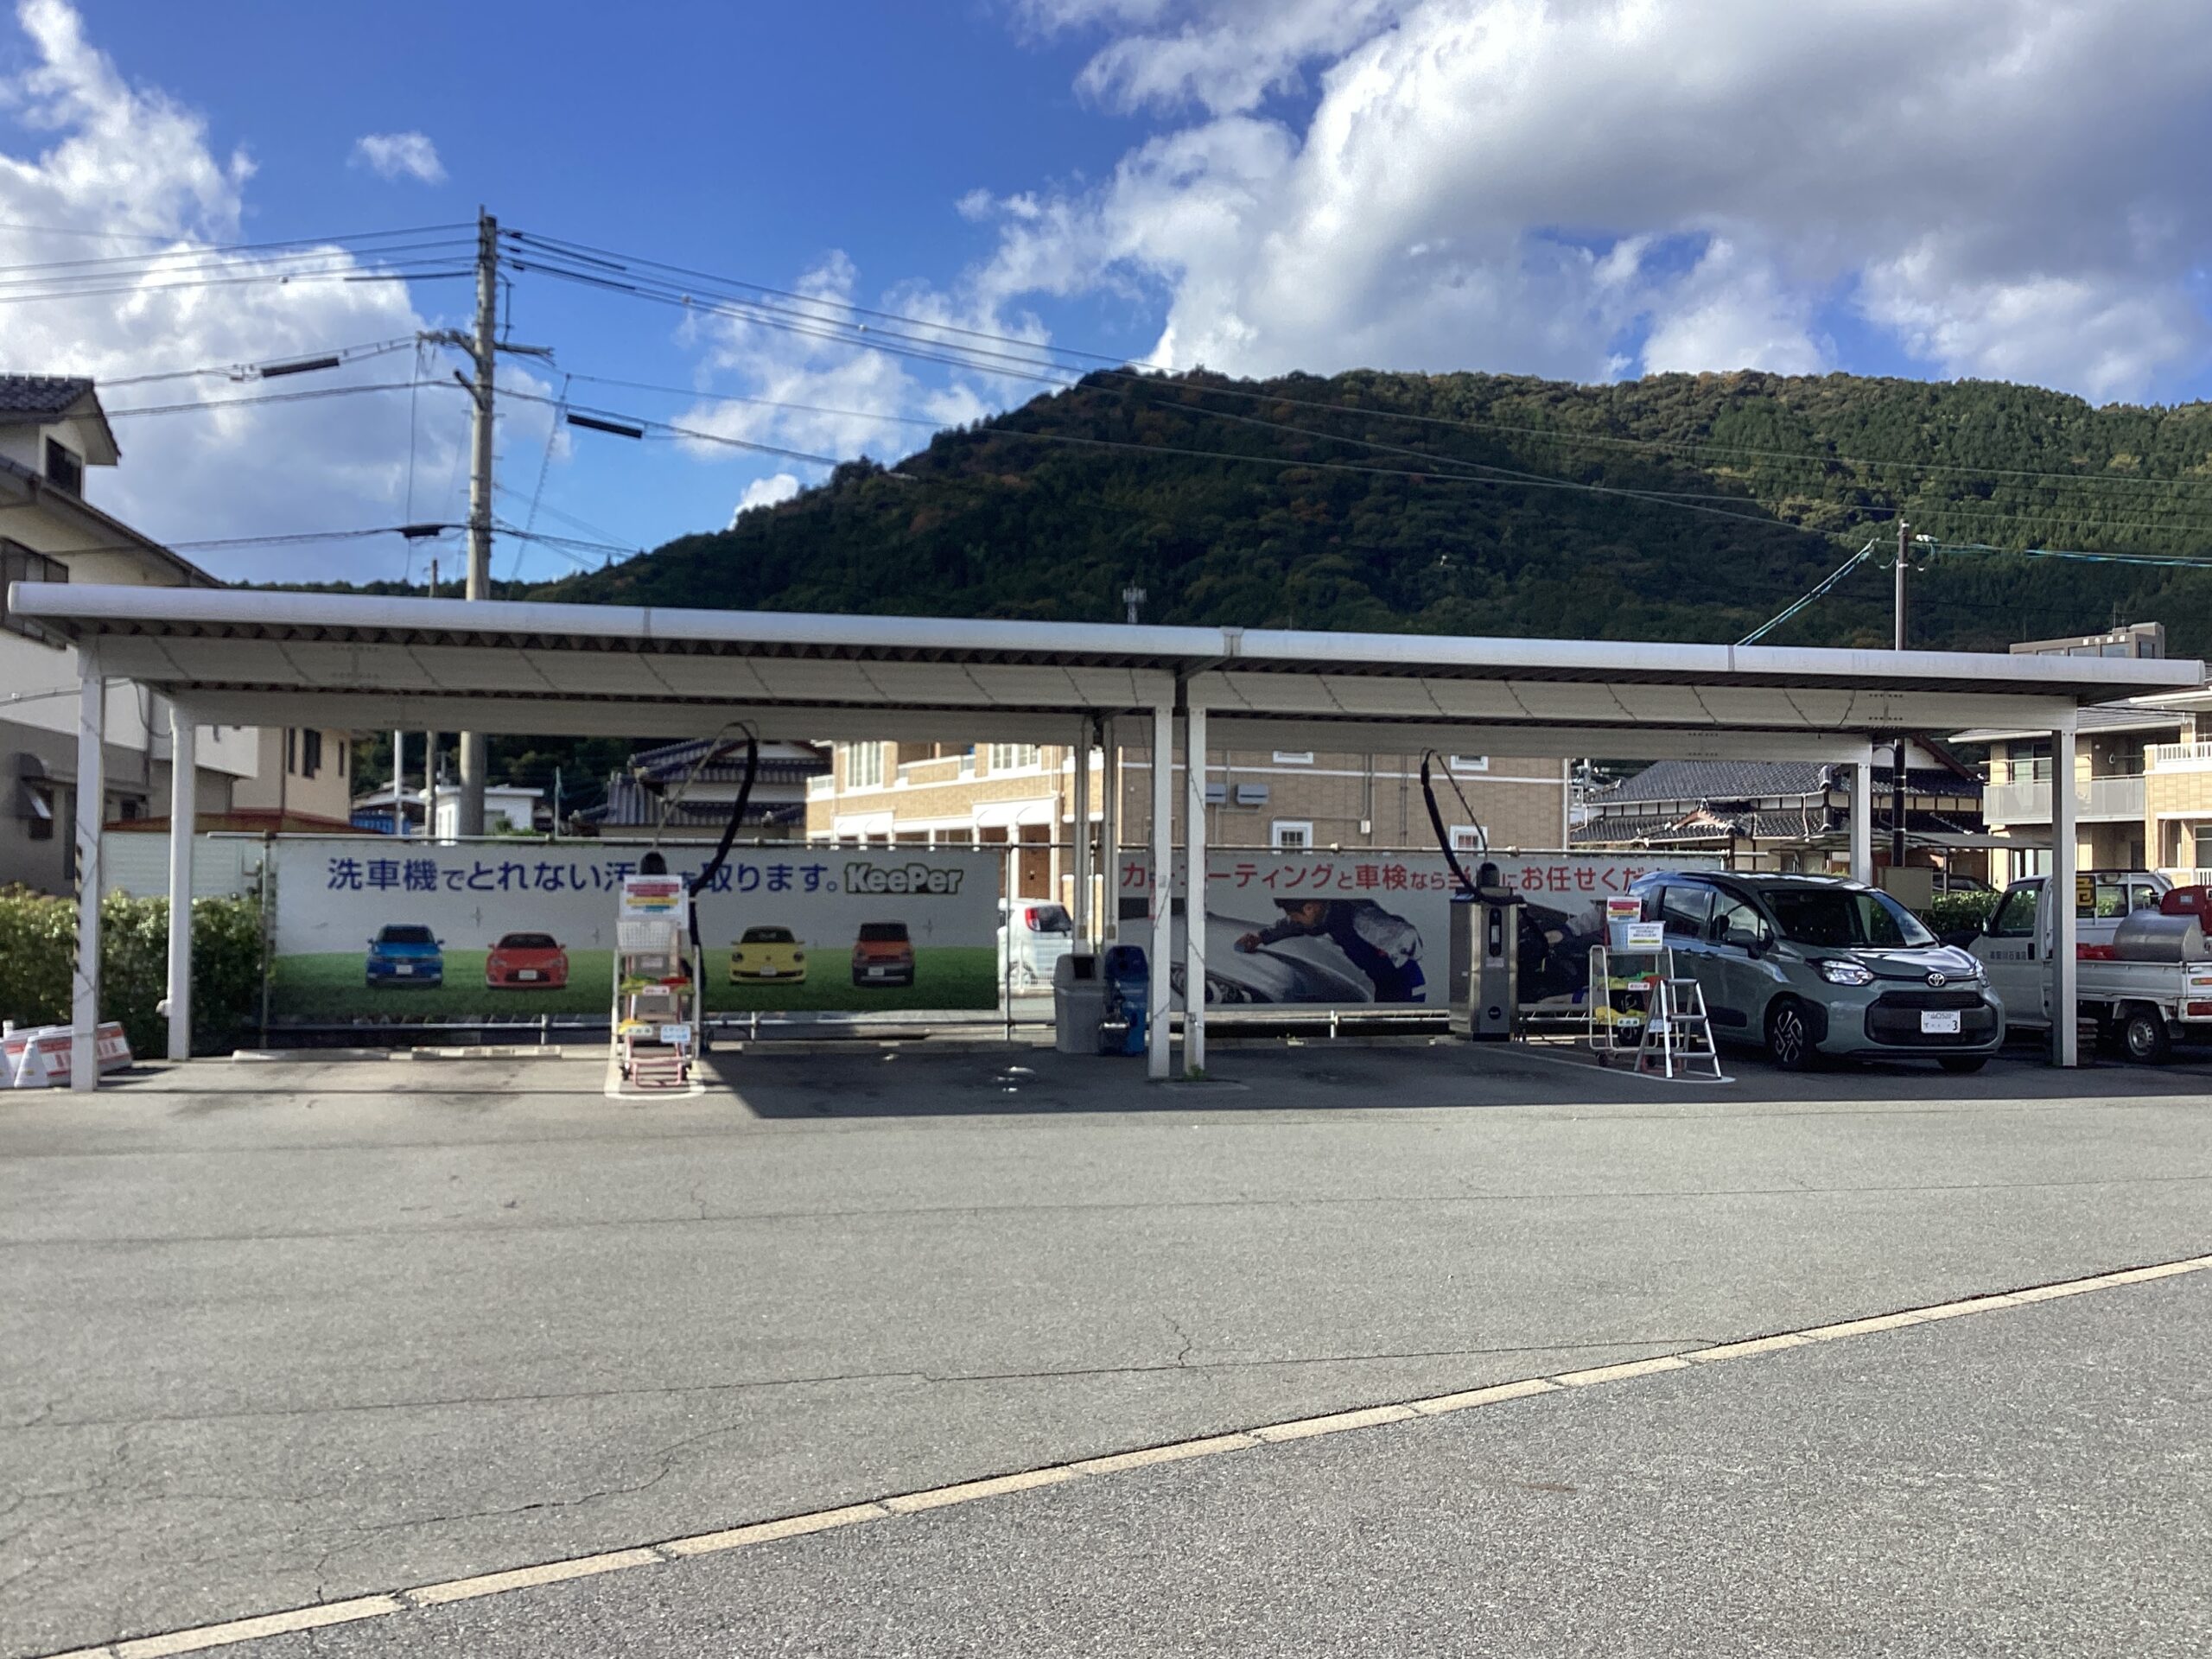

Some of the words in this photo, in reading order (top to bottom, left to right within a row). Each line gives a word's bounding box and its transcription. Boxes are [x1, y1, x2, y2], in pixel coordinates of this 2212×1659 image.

[327, 858, 837, 893] 洗車機でとれない汚を取ります。
[844, 861, 964, 894] KeePer
